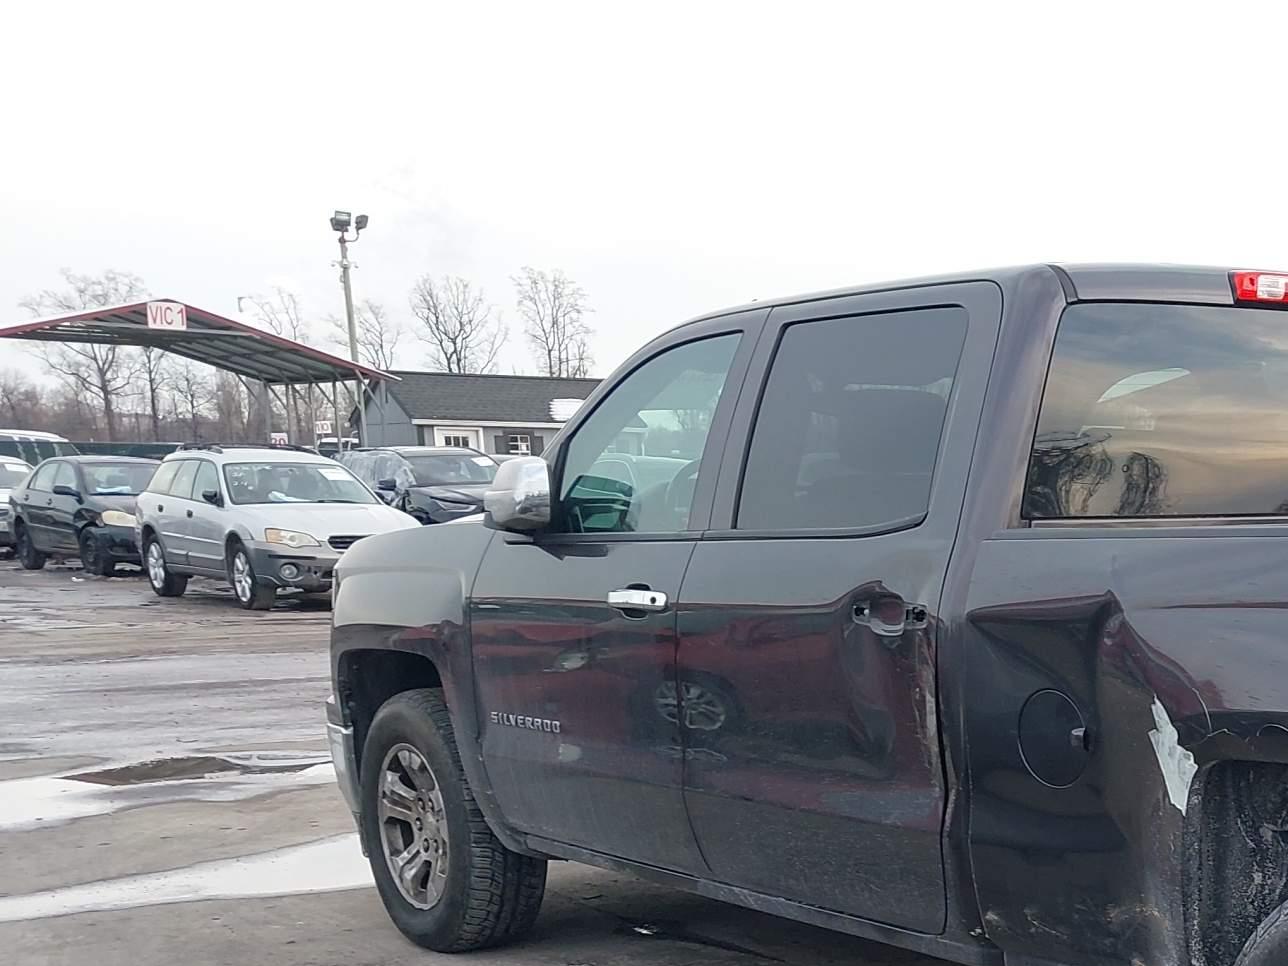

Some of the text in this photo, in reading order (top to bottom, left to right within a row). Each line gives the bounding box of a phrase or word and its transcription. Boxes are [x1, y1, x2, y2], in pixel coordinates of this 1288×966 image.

[149, 305, 185, 326] VIC 1
[490, 711, 561, 733] SILVERADO
